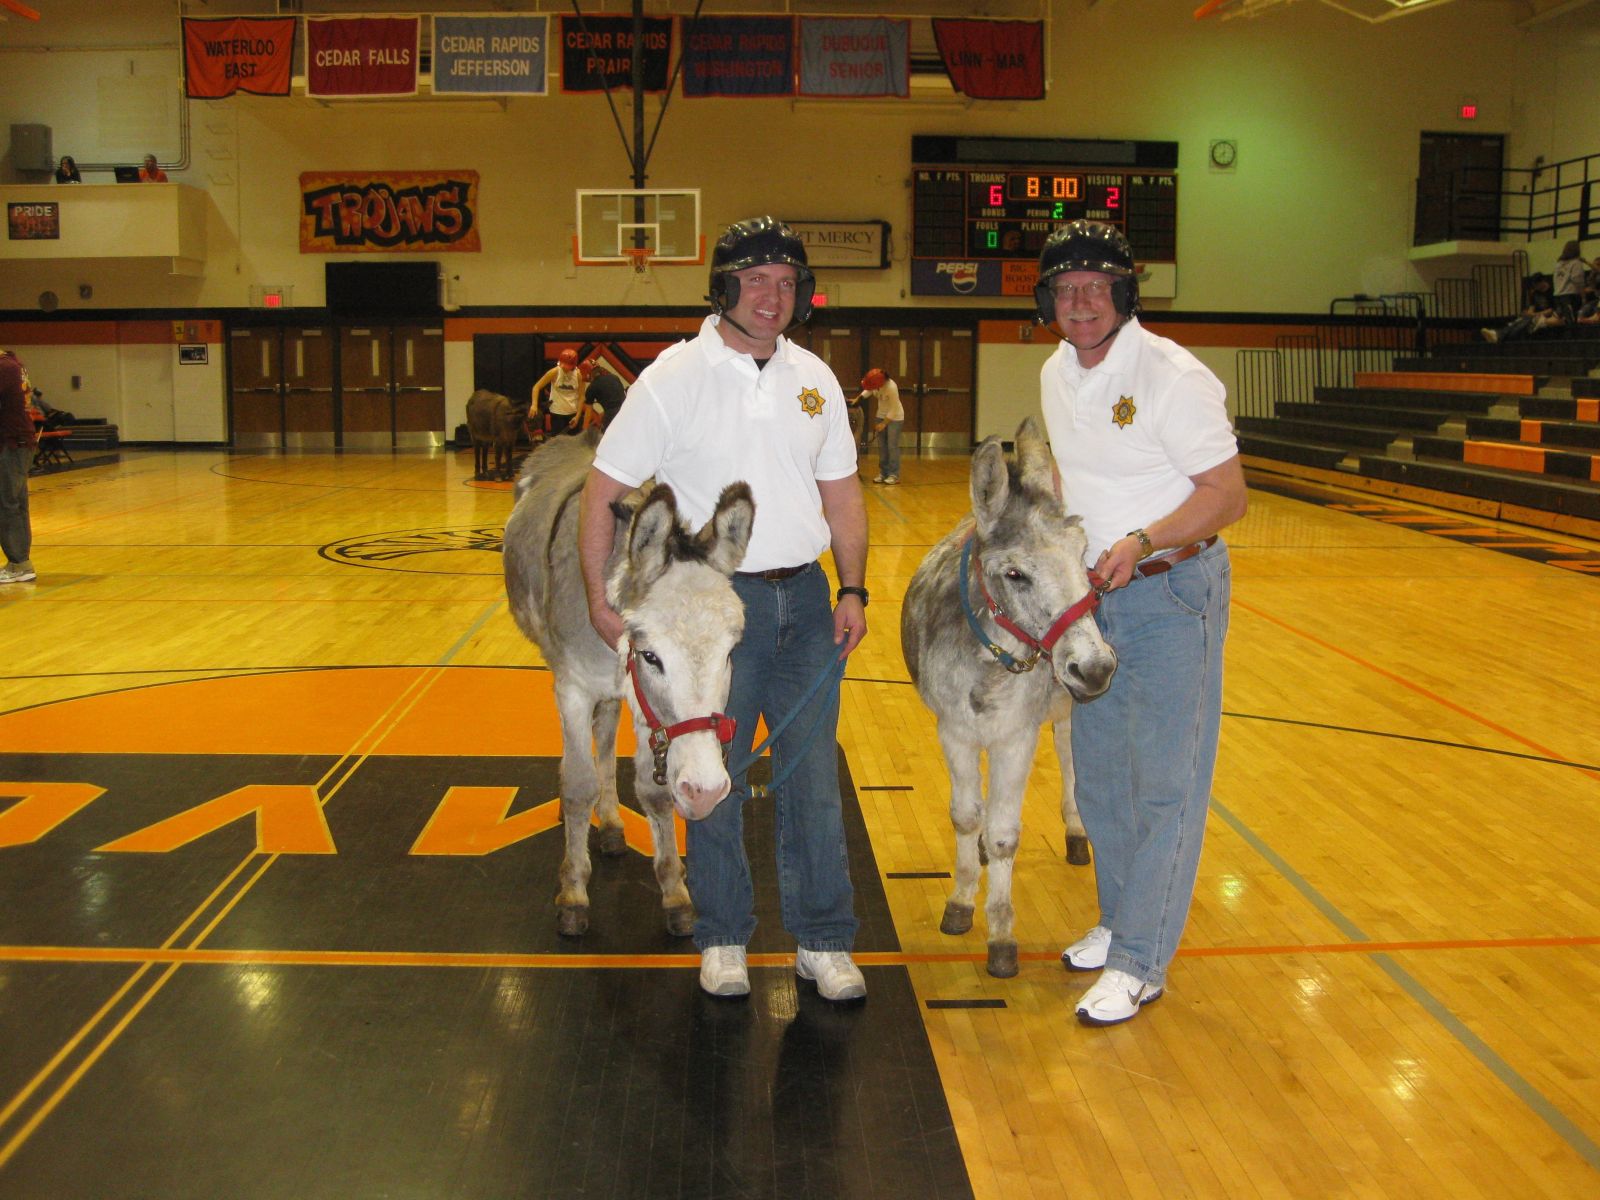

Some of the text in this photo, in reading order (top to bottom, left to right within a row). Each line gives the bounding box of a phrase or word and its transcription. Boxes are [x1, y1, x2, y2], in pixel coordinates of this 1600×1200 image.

[205, 38, 275, 59] WATERLOO
[441, 35, 540, 53] CEDAR RAPIDS
[567, 31, 667, 49] CEDAR RAIDS
[690, 33, 785, 51] CEDAR RAPIDS
[316, 48, 410, 68] CEDAR FALLS
[587, 57, 646, 75] PRAIR
[224, 62, 258, 80] EAST
[450, 58, 531, 77] JEFFERSON
[694, 59, 783, 78] WASHINGTON
[829, 57, 885, 78] SENIOR
[970, 173, 1006, 183] TROJANS
[1087, 175, 1122, 186] VISITOR
[989, 184, 1003, 207] 6
[1027, 176, 1078, 199] 8:00
[1105, 186, 1120, 209] 2
[14, 205, 52, 217] PRIDE
[312, 185, 469, 241] TROJANS
[981, 208, 1006, 218] BONUS
[1027, 202, 1063, 219] PERIOD 2
[1085, 209, 1110, 219] BONUS
[976, 221, 999, 230] FOULS
[1021, 222, 1048, 232] PLAYER
[818, 231, 874, 244] MERCY
[987, 231, 997, 248] 0
[936, 262, 979, 275] PEPSI
